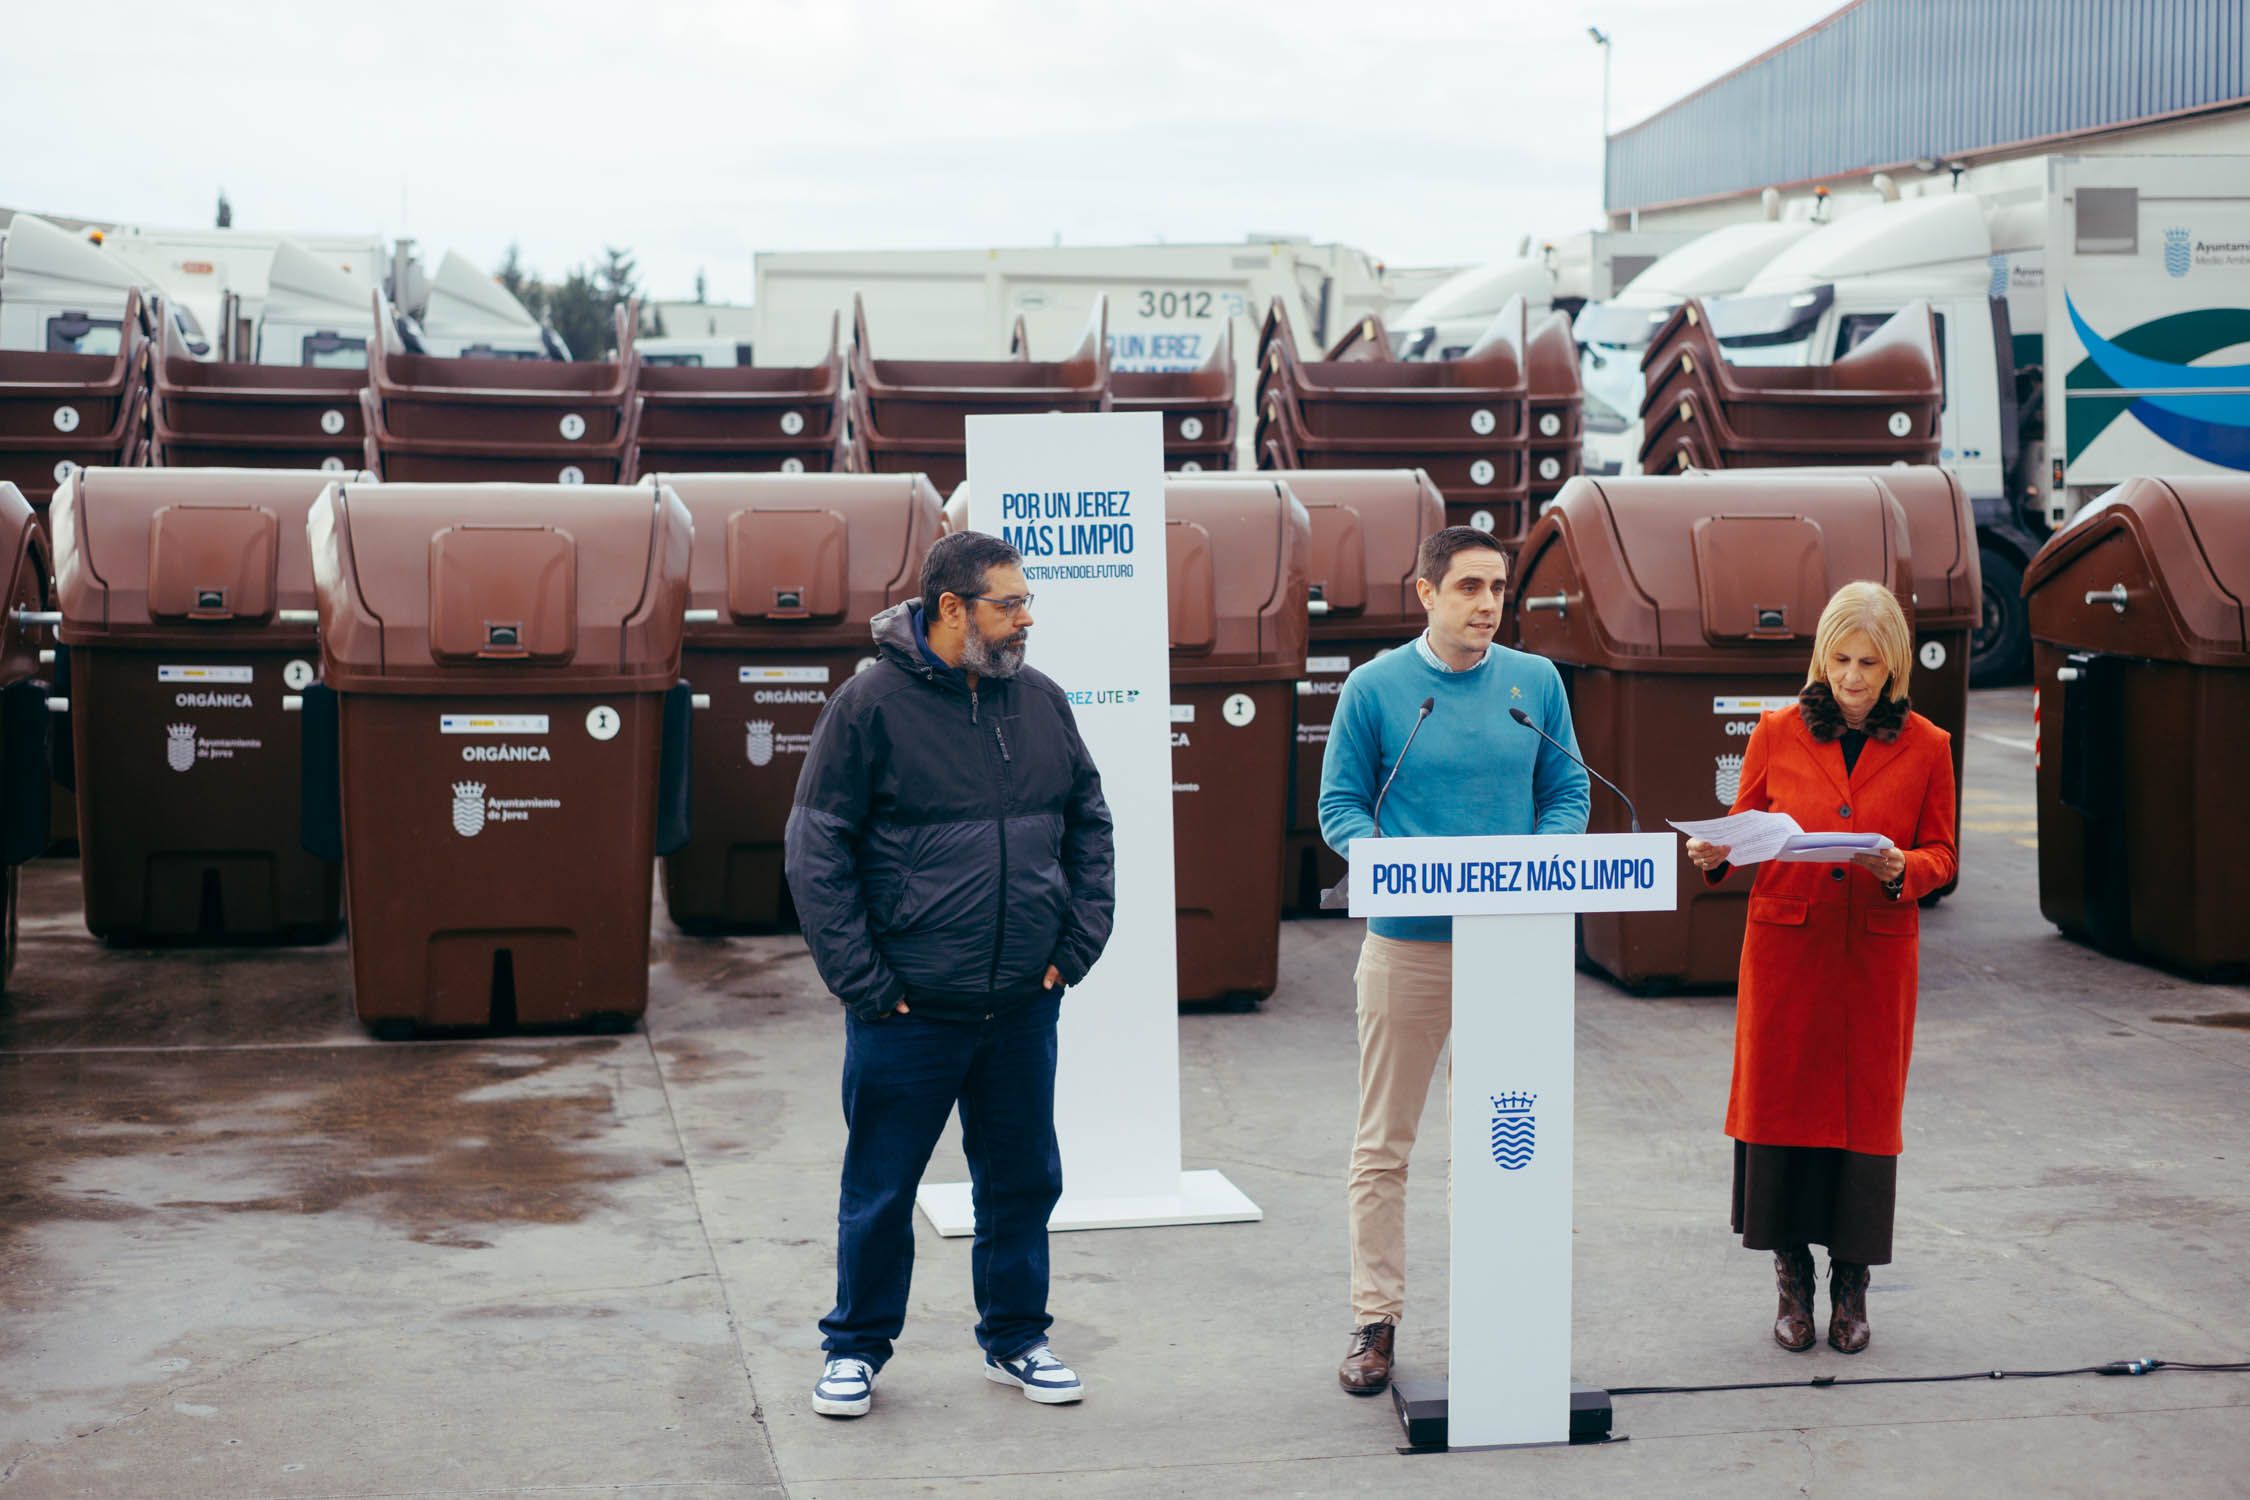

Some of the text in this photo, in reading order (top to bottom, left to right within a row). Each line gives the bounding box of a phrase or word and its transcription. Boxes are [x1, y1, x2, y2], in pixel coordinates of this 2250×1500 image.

[1138, 290, 1212, 318] 3012
[1120, 335, 1144, 358] UN
[1150, 334, 1201, 358] JEREZ
[1002, 490, 1130, 519] POR UN JEREZ
[1002, 519, 1134, 556] MÁS LIMPIO
[1022, 564, 1134, 581] NSTRUYENDOELFUTURO
[175, 691, 253, 708] ORGÁNICA
[754, 688, 827, 704] ORGÁNICA
[1065, 690, 1124, 704] REZ UTE
[198, 738, 262, 749] Ayuntamiento
[197, 749, 209, 758] de
[462, 743, 551, 762] ORGÁNICA
[488, 797, 561, 811] Ayuntamiento
[487, 810, 528, 822] de Jerez
[1373, 854, 1654, 895] POR UN JEREZ MÁS LIMPIO
